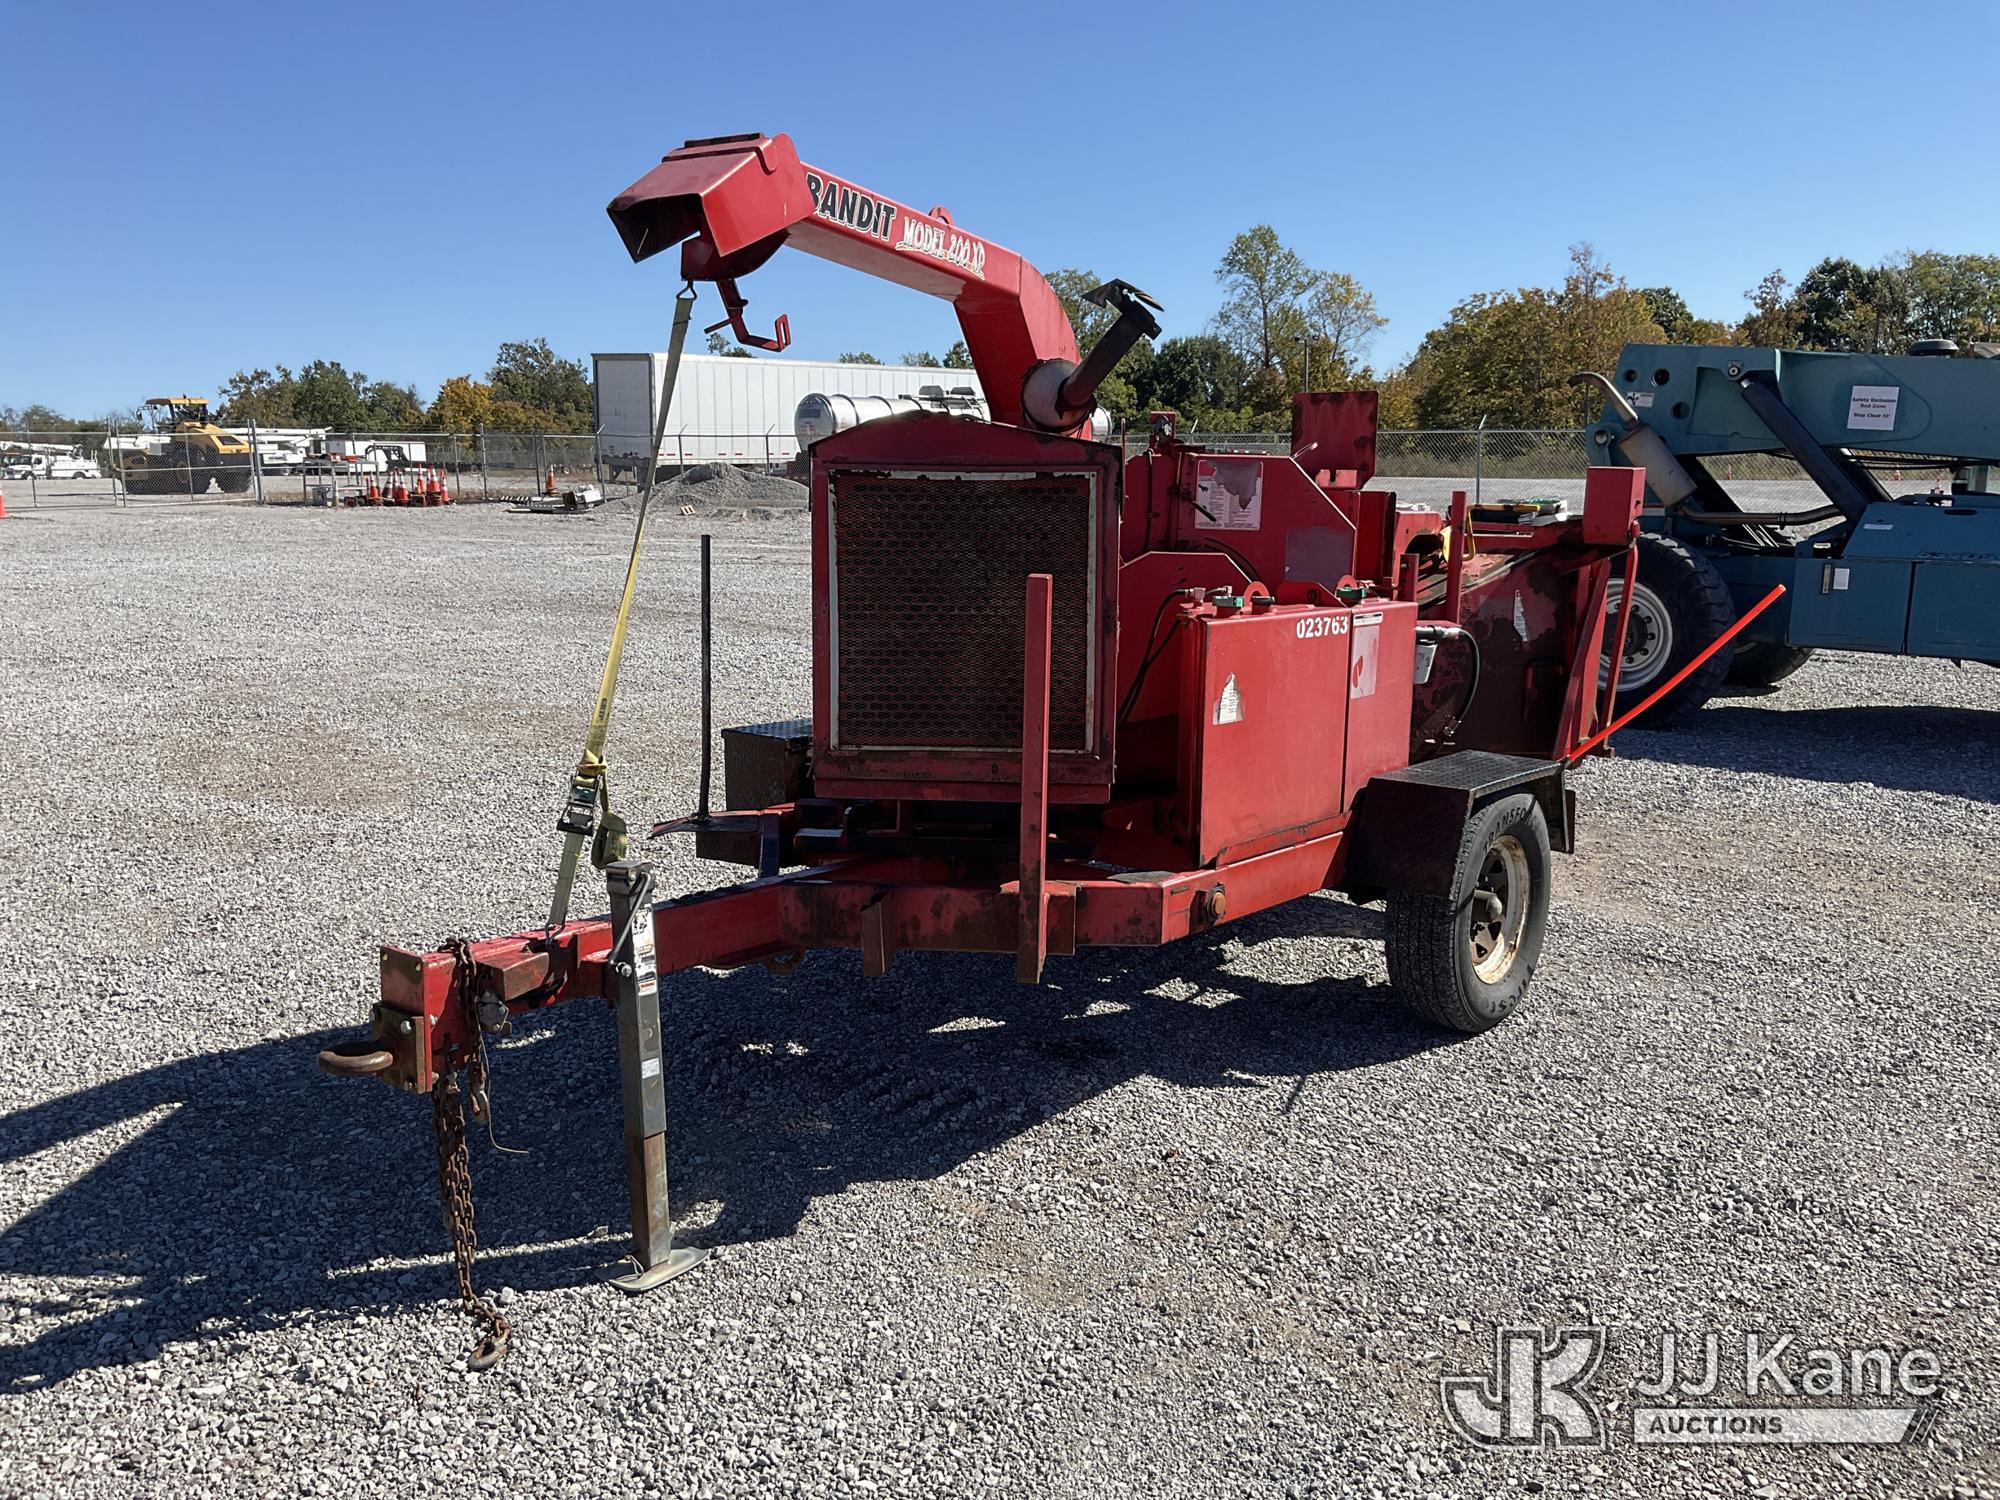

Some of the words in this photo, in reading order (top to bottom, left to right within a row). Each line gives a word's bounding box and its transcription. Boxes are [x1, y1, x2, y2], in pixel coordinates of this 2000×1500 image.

[806, 172, 896, 241] BANDIT
[903, 216, 945, 259] MODEL
[1296, 615, 1348, 639] 023763
